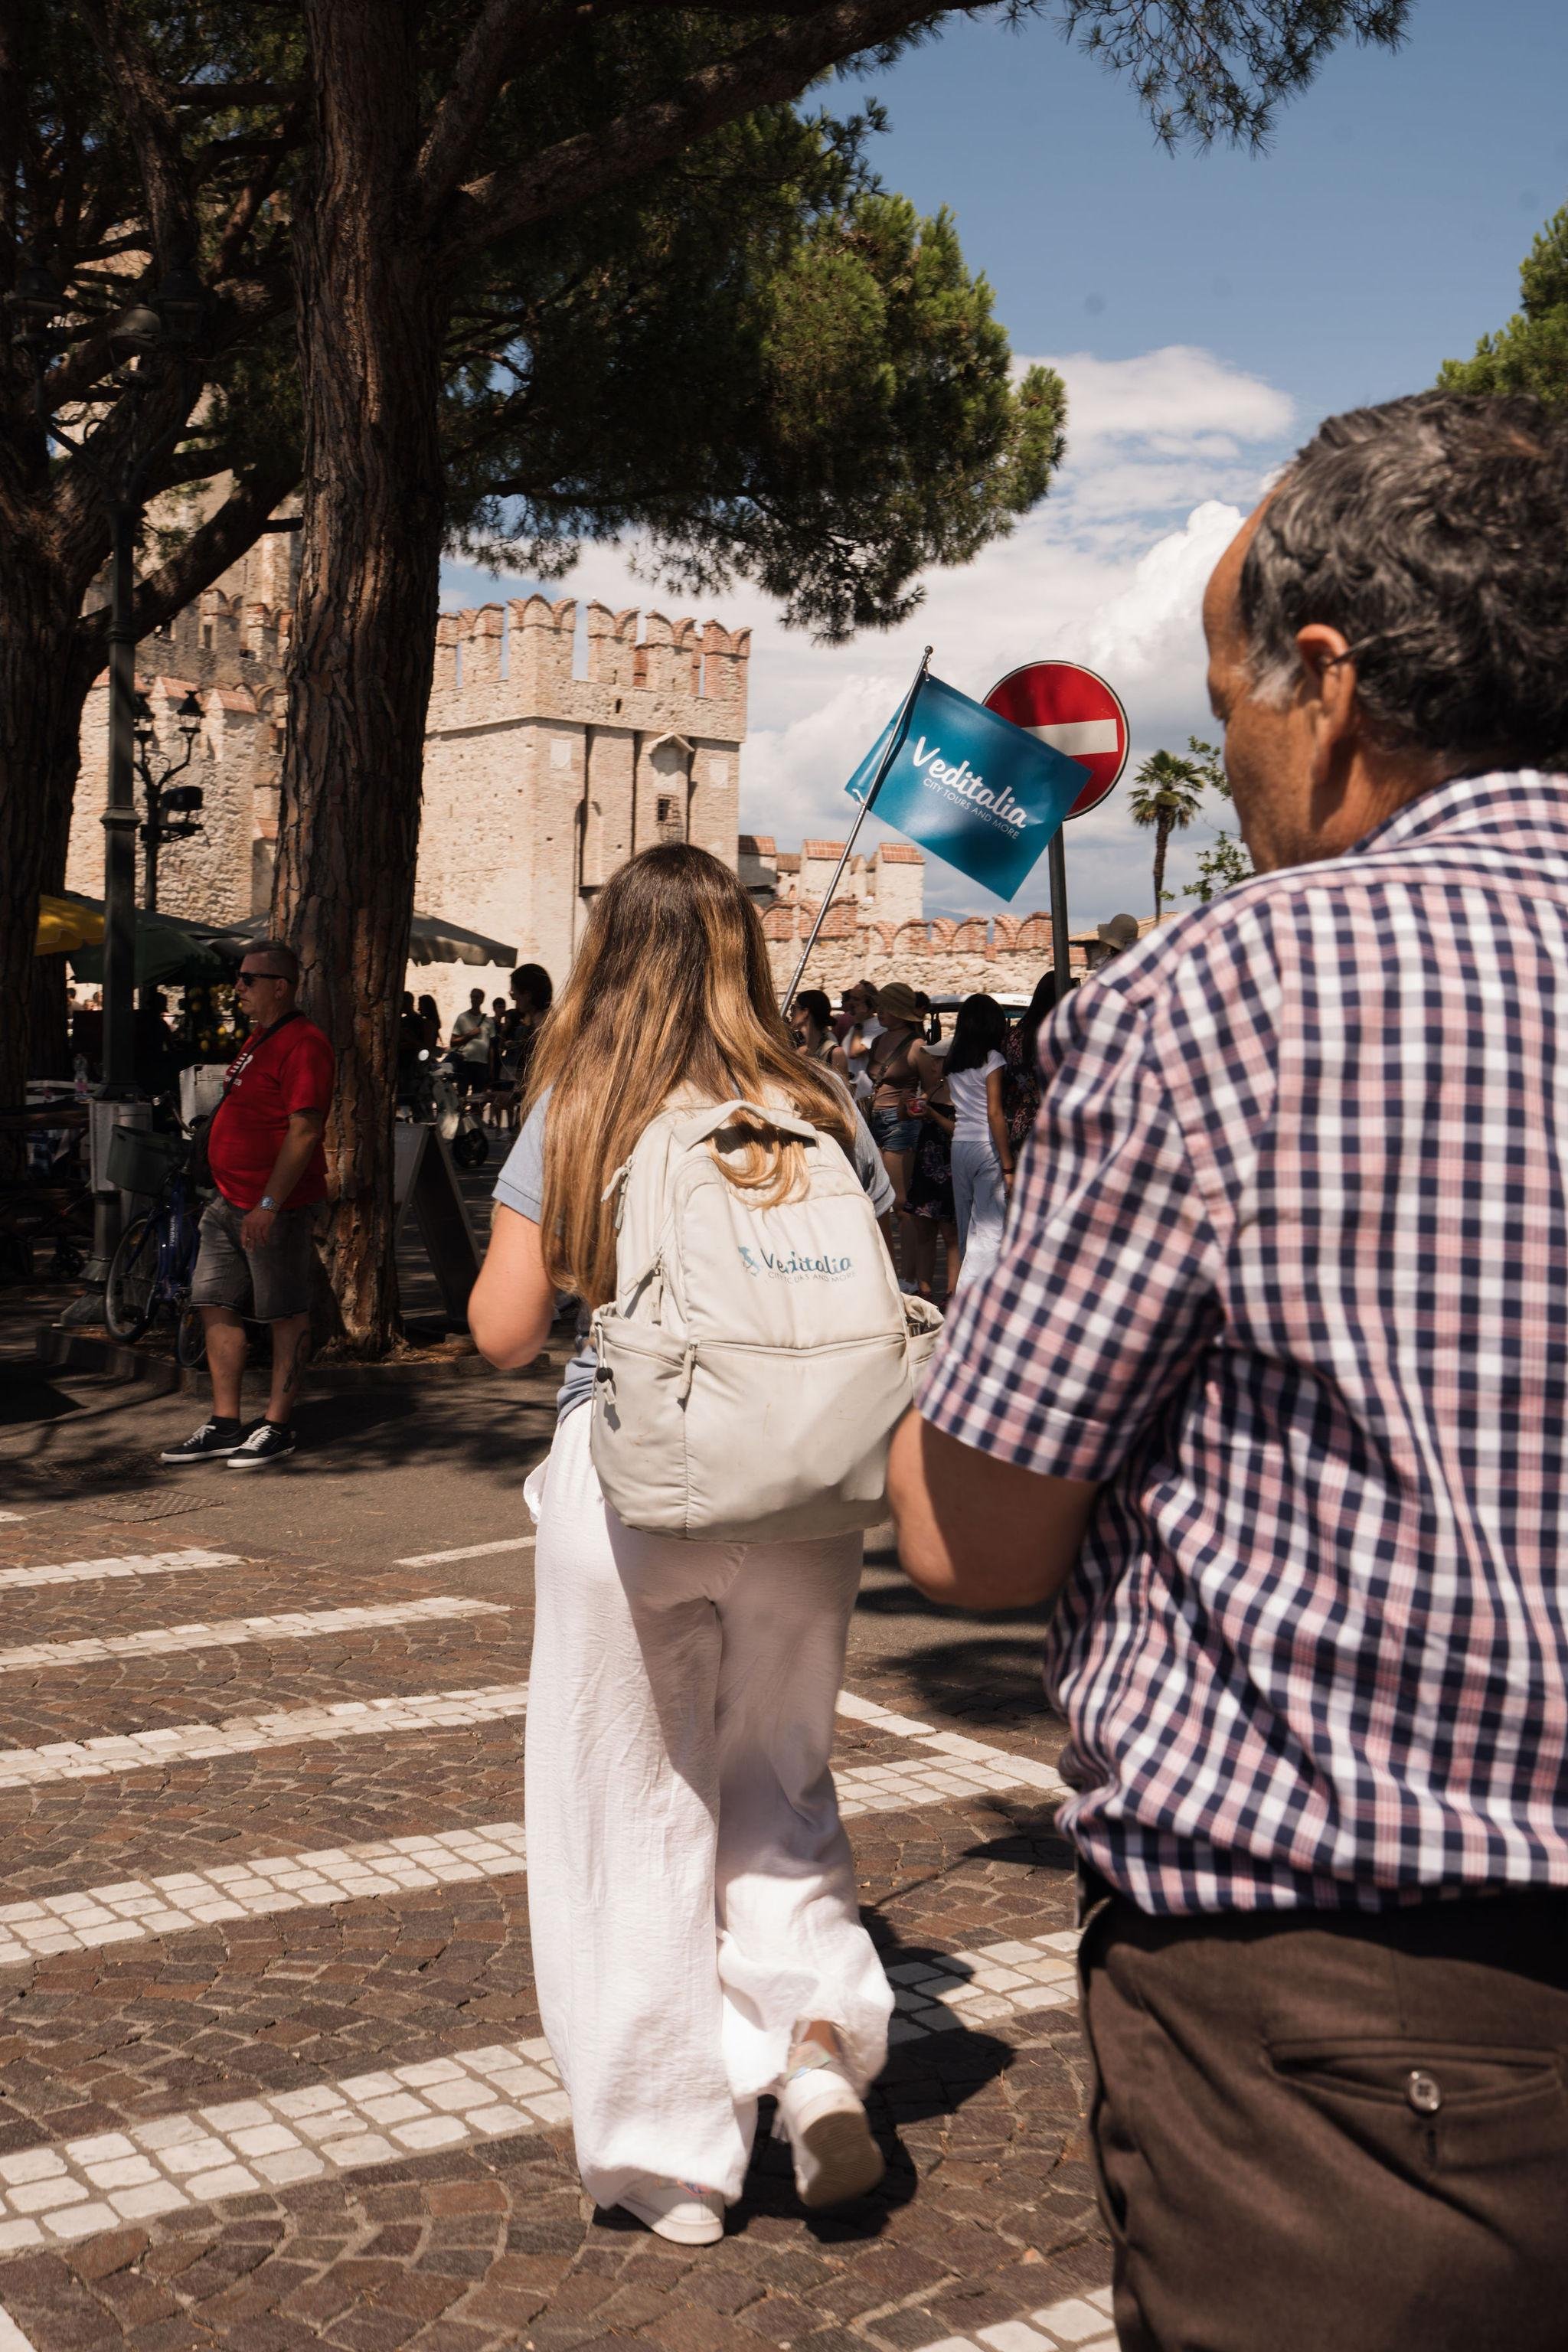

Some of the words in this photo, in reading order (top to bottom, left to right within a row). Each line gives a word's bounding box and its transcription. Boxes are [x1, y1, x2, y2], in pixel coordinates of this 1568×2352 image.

[913, 736, 1027, 828] Veditalia
[923, 778, 944, 793] CITY
[943, 789, 972, 810] TOURS
[971, 807, 991, 822] AND
[992, 819, 1020, 840] MORE
